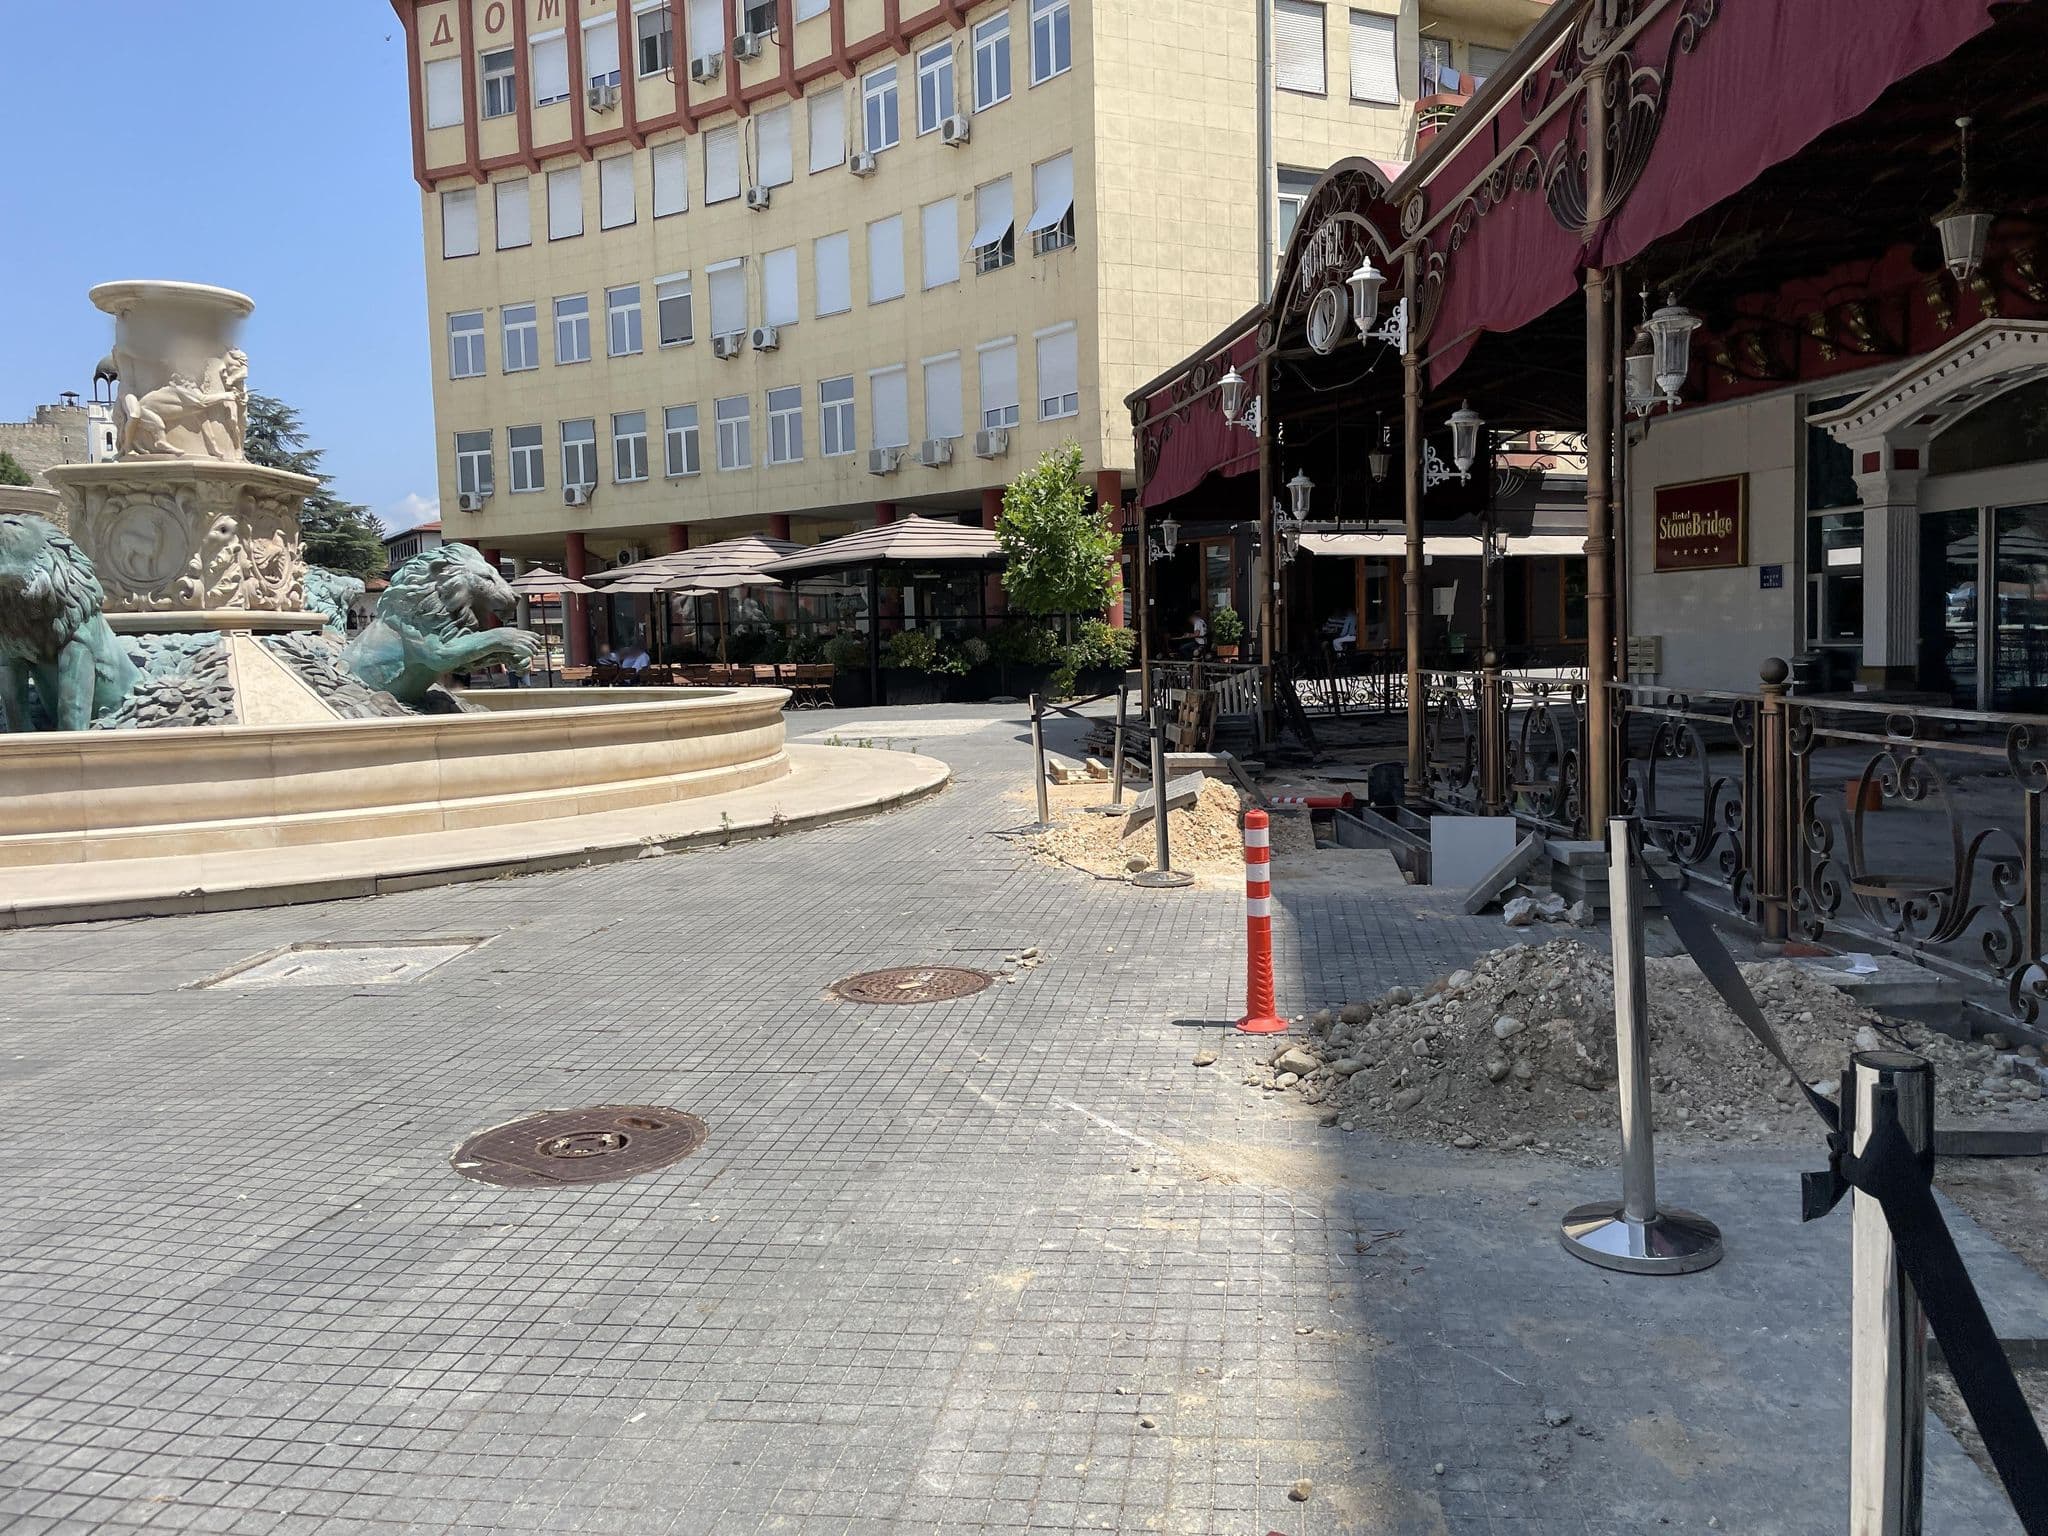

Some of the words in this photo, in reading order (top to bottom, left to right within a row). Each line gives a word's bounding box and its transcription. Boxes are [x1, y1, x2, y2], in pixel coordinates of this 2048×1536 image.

[430, 0, 606, 46] ДОМ
[1660, 510, 1733, 540] StoneBridge
[1672, 510, 1690, 521] Hotel
